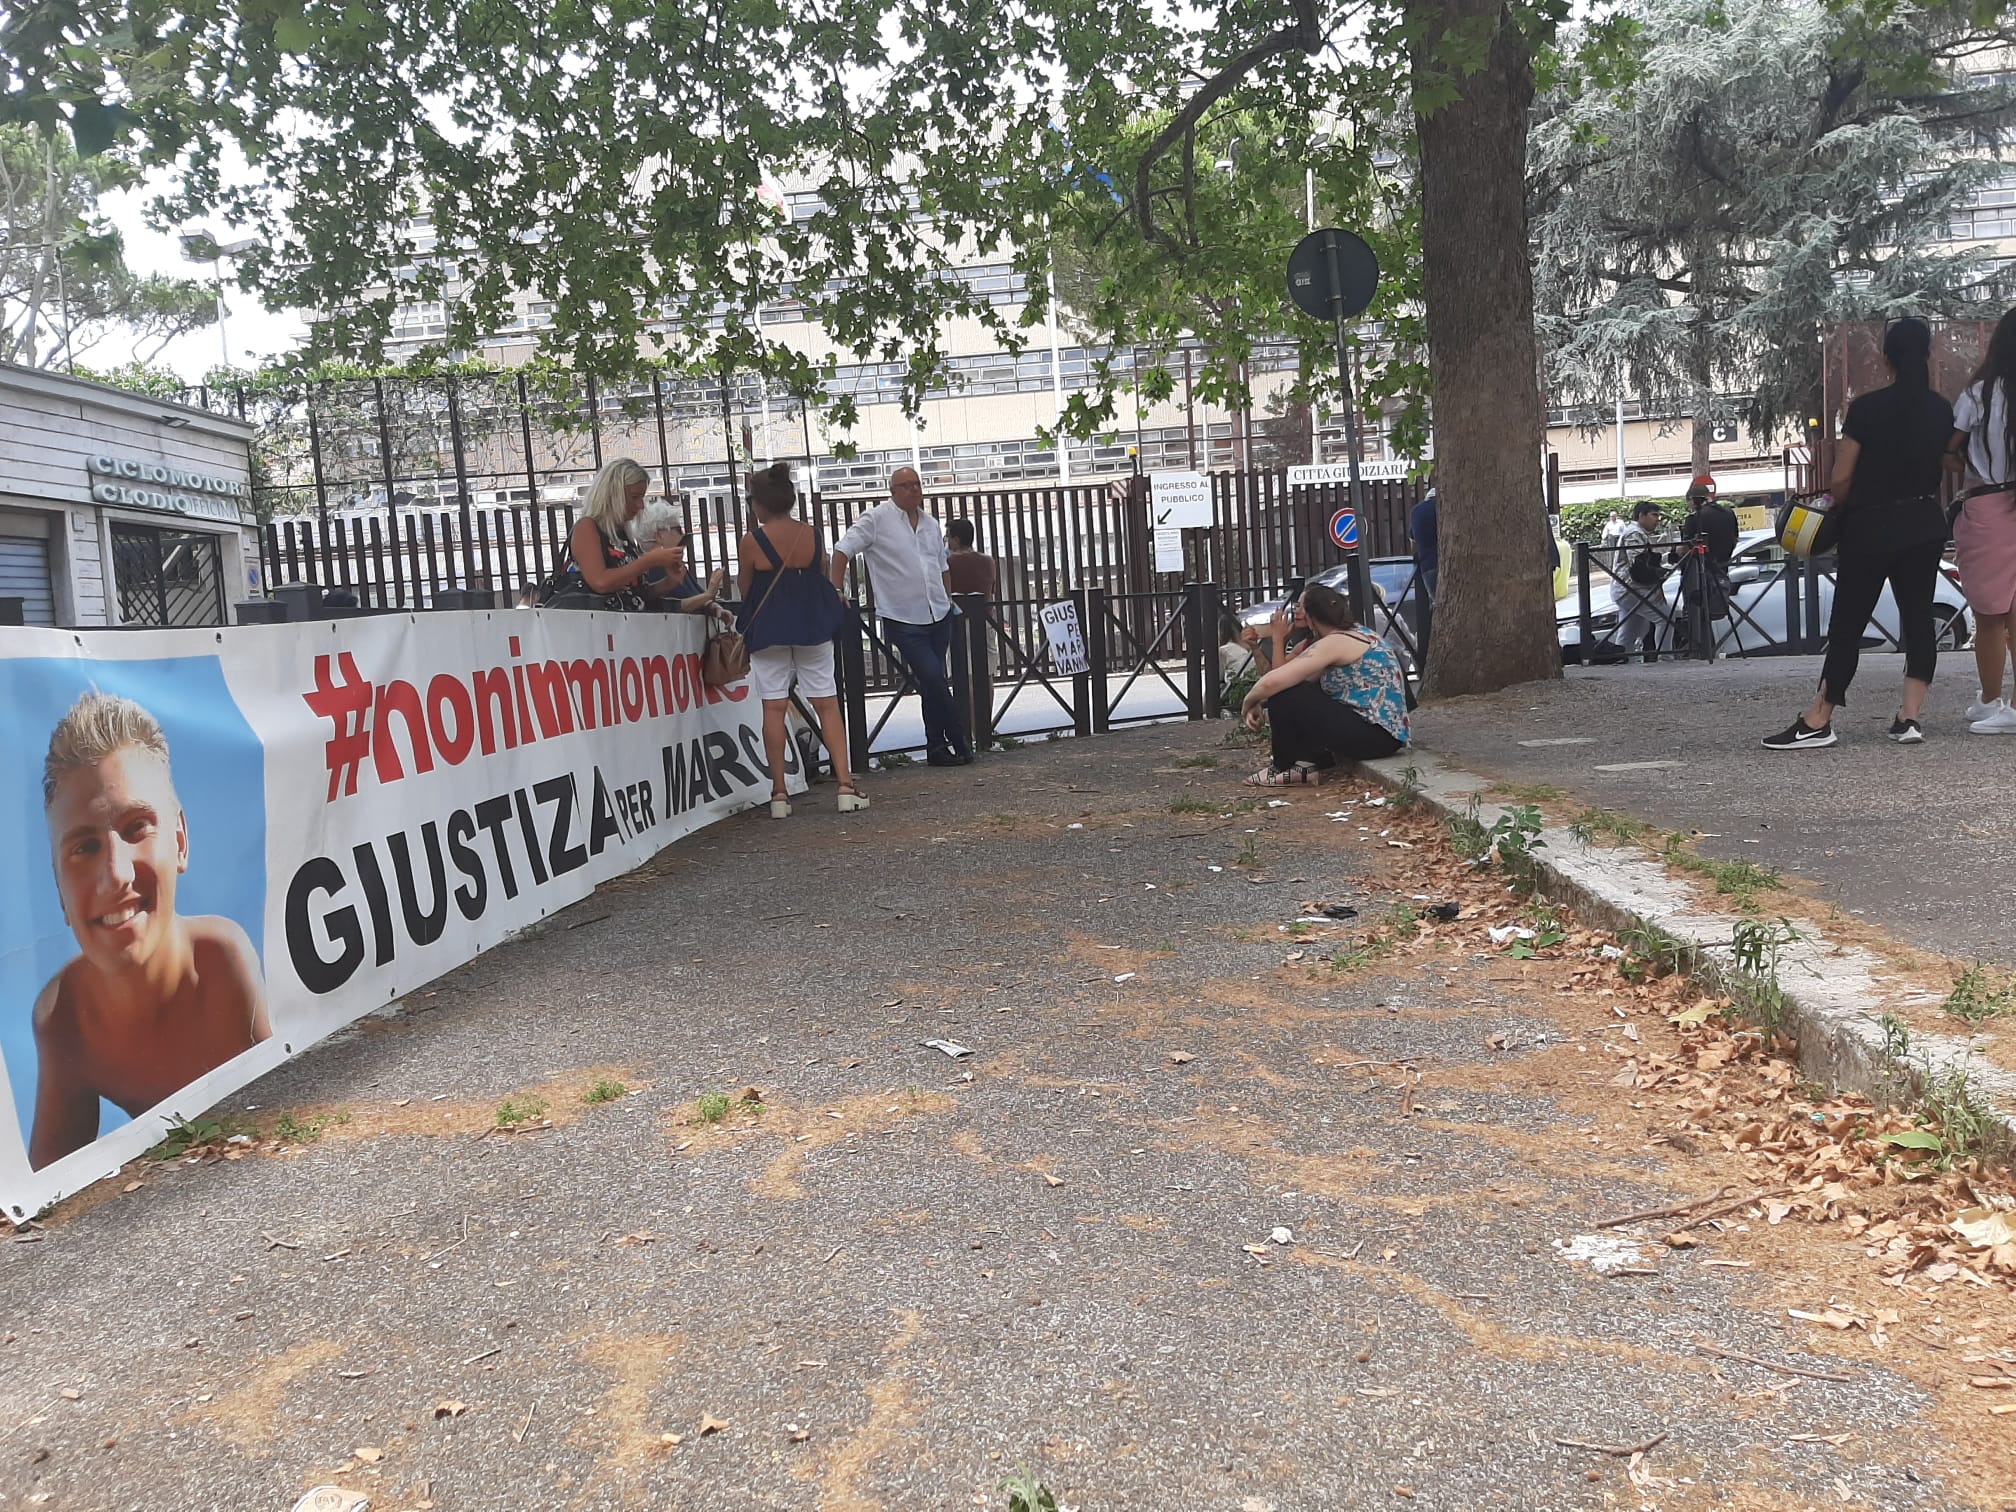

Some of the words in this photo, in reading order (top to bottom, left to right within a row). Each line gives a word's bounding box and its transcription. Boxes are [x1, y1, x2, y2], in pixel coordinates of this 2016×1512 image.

[1712, 427, 1727, 441] C
[96, 455, 241, 496] CICLOMOTOR
[1153, 481, 1197, 490] INGRESSO
[102, 484, 189, 512] CLODIO
[1161, 494, 1205, 503] PUBBLICO
[1044, 604, 1075, 624] GIUS
[614, 780, 656, 839] PER
